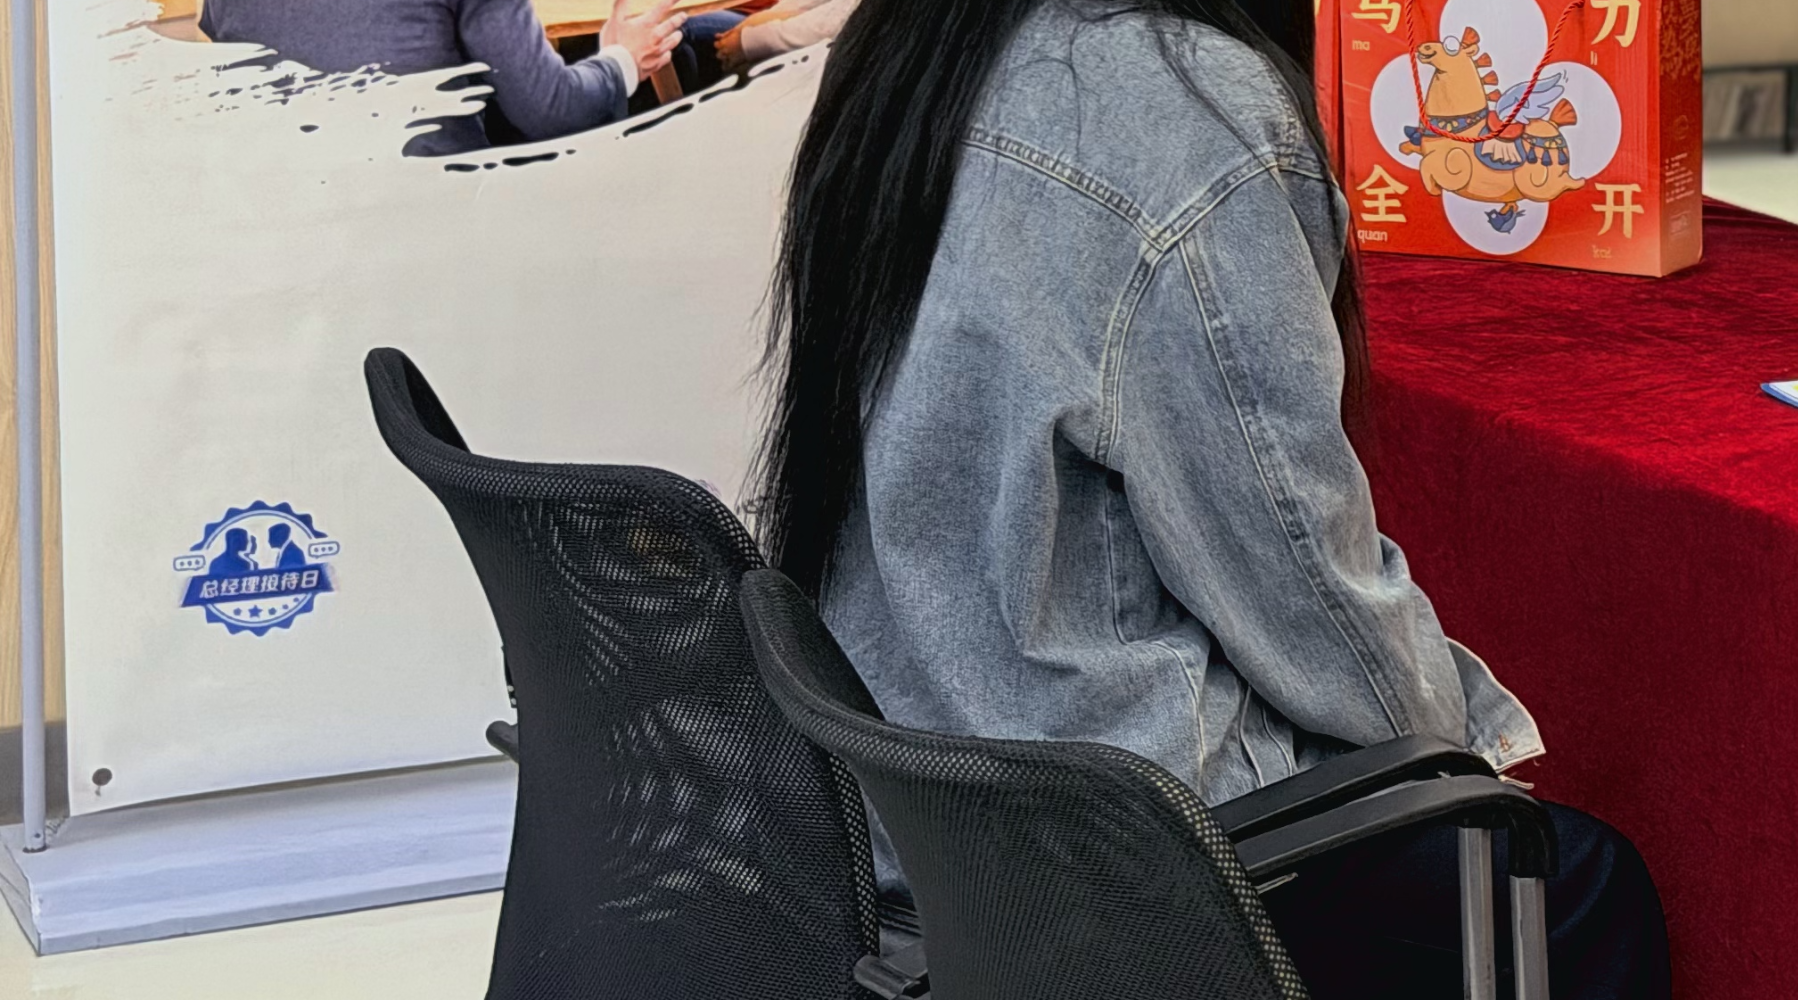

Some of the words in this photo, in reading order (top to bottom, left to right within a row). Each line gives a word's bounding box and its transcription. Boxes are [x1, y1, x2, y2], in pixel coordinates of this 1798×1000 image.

[1356, 164, 1409, 223] 全
[1591, 182, 1645, 239] 开
[1357, 229, 1388, 244] quan
[200, 570, 319, 598] 总经理接待日
